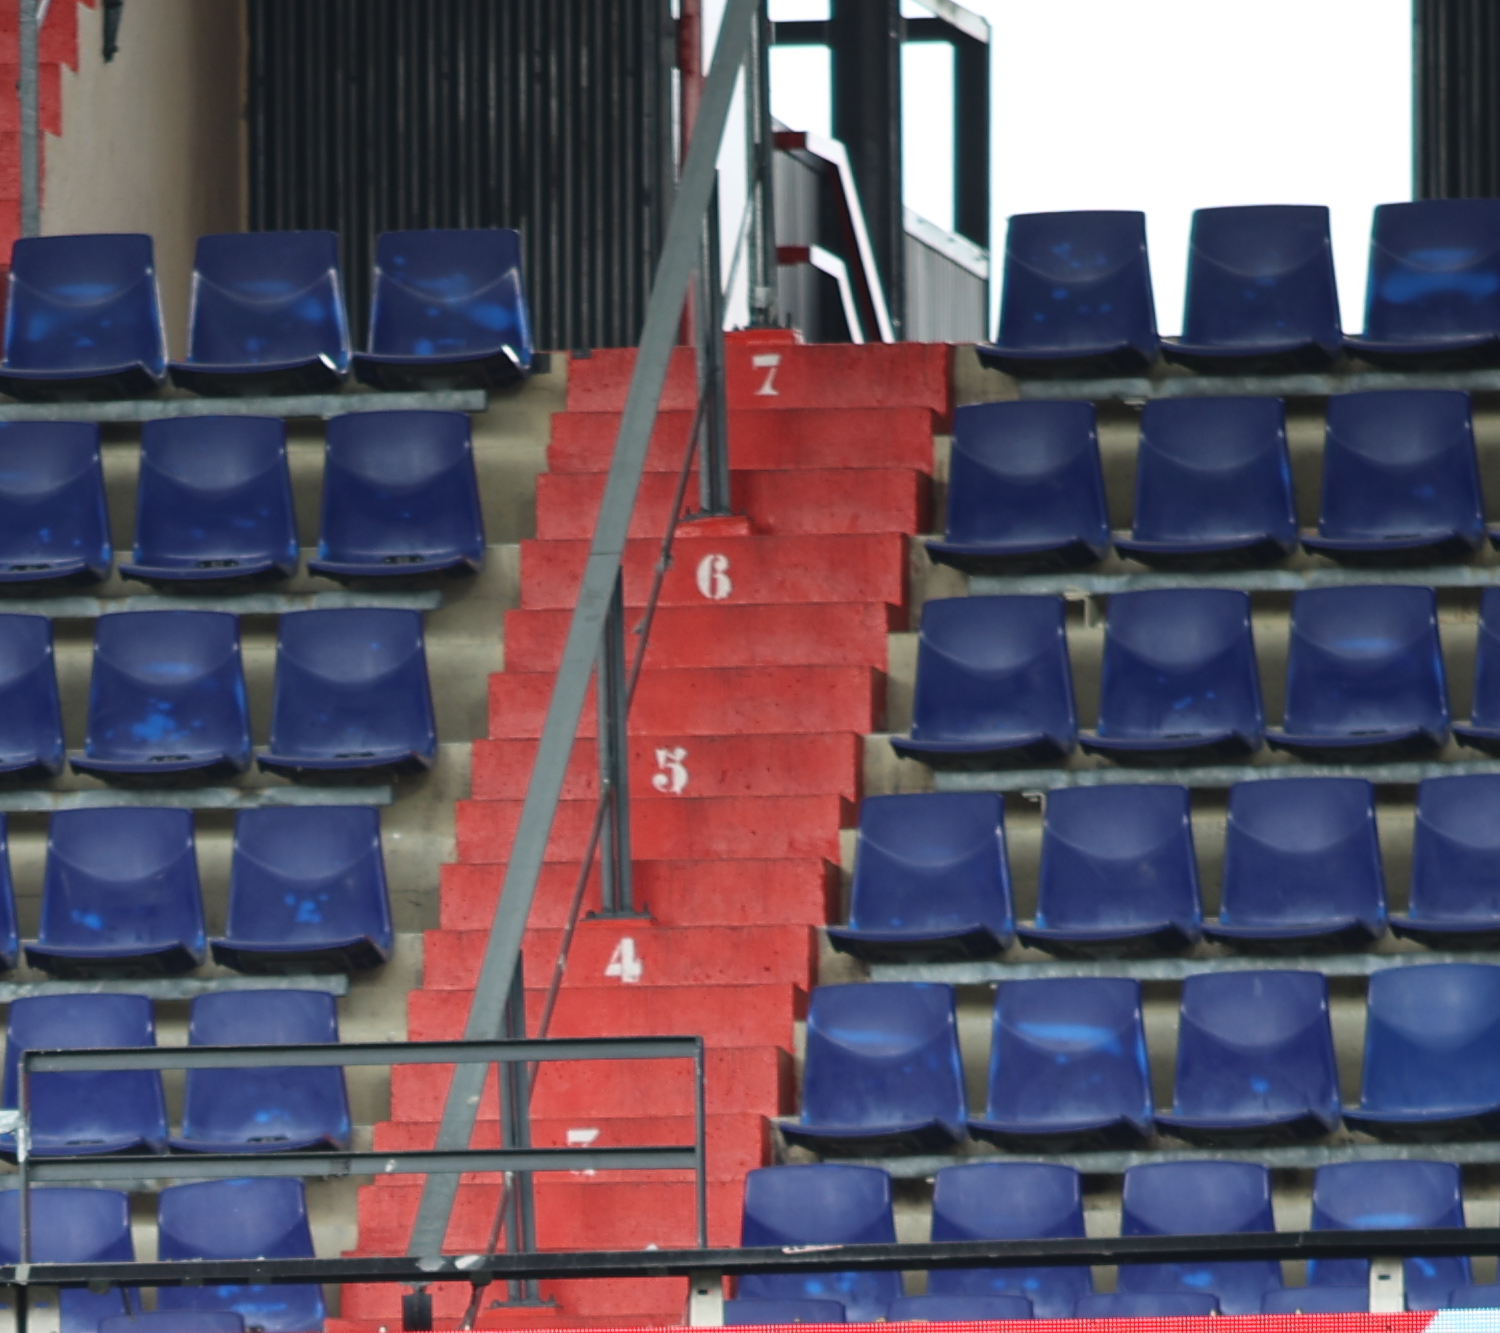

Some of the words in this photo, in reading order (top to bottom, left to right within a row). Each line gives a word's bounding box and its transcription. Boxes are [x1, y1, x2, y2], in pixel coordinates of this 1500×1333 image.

[751, 353, 782, 396] 7
[696, 552, 733, 600] 6
[652, 746, 688, 795] 5
[604, 936, 643, 984] 4
